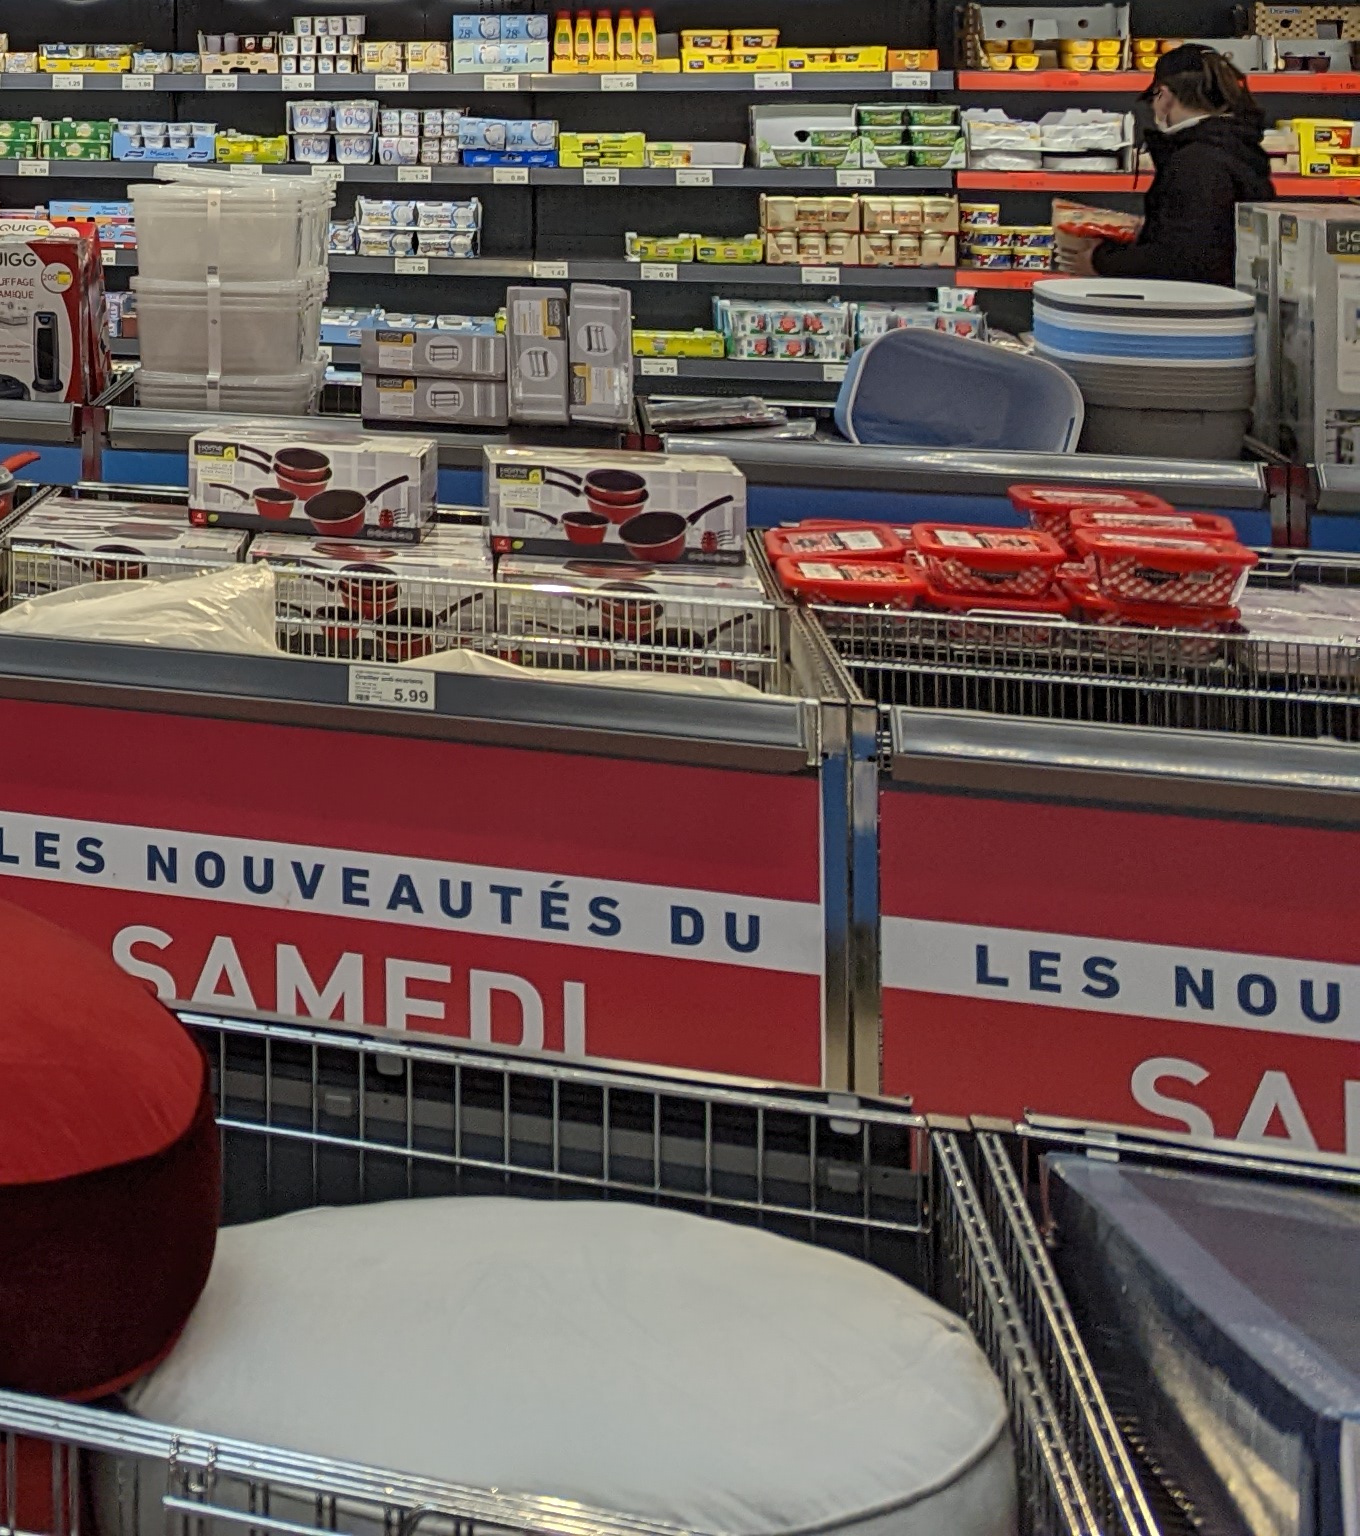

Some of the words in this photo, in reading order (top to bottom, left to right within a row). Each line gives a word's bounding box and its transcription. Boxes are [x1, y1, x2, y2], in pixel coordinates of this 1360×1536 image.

[0, 223, 50, 235] QUIGG
[393, 688, 429, 703] 5.99
[146, 843, 622, 938] NOUVEAUTÉS
[670, 904, 761, 955] DU
[111, 924, 586, 1057] SAMEDI
[975, 944, 1121, 1000] LES
